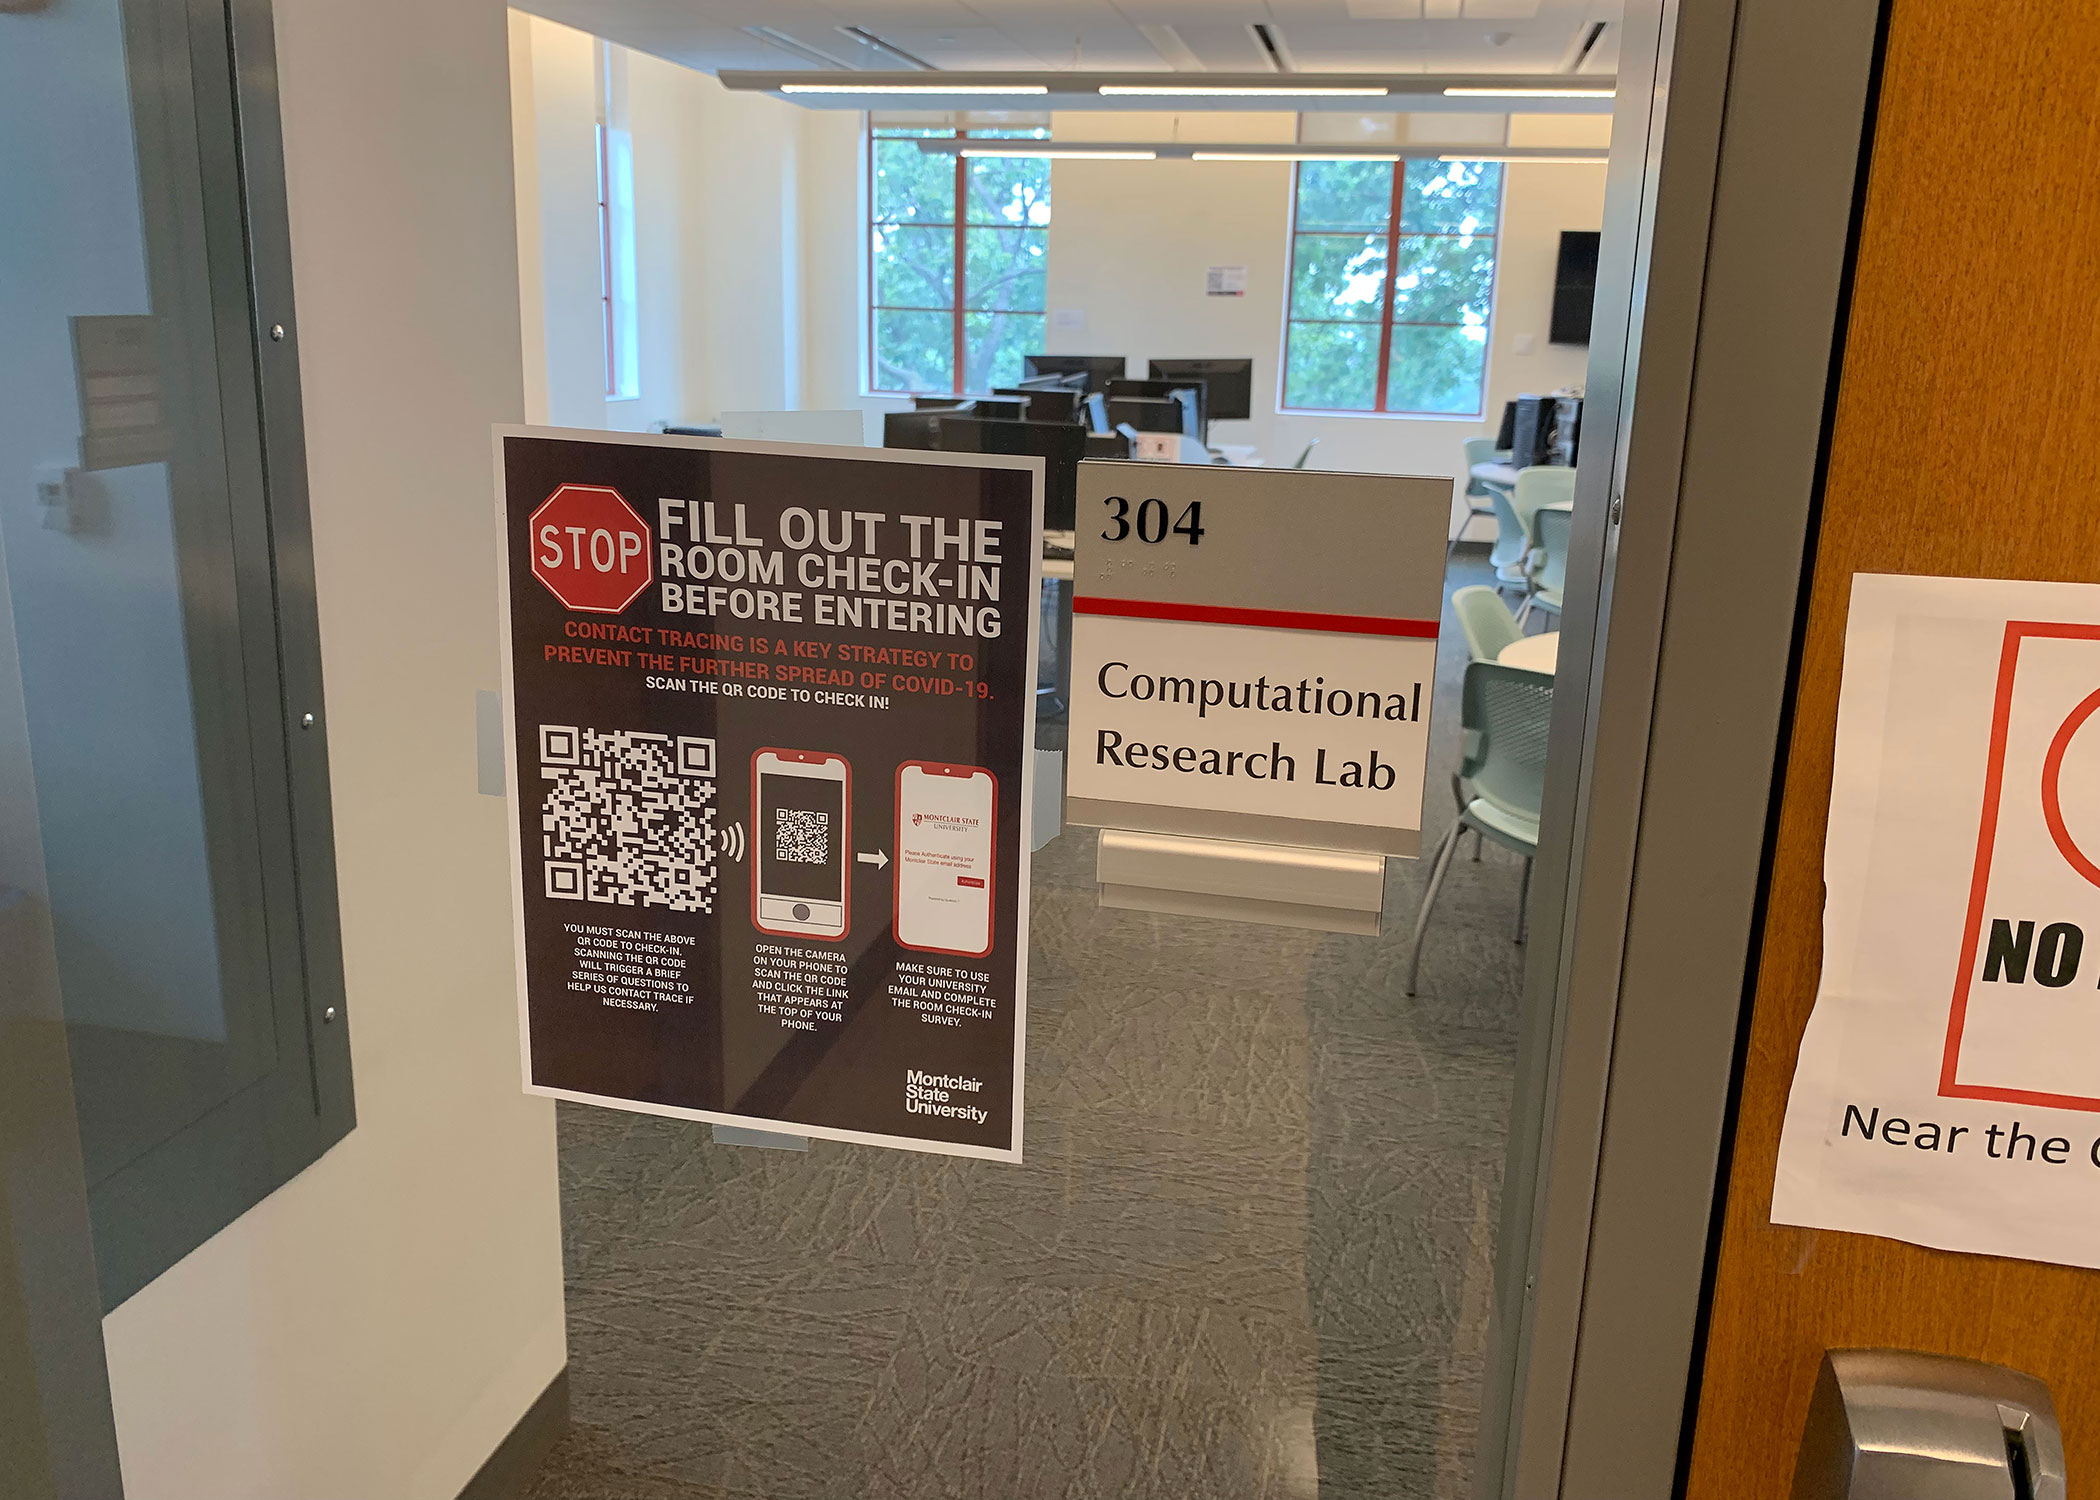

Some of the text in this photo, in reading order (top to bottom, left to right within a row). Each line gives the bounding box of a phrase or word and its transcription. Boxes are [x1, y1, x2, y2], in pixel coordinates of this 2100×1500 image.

[659, 498, 1002, 564] FILL OUT THE
[1101, 496, 1204, 545] 304
[540, 525, 642, 574] STOP
[661, 543, 1000, 601] ROOM CHECK-IN
[662, 583, 1001, 638] BEFORE ENTERING
[565, 621, 973, 672] CONTACT TRACING IS A KEY STRATEGY TO
[544, 645, 994, 699] PREVENT THE FURTHER SPREAD OF COVID-19.
[645, 676, 889, 710] SCAN THE QR CODE TO CHECK IN!
[1098, 662, 1420, 722] Computational
[1096, 729, 1396, 790] Research Lab
[924, 814, 960, 823] MONTCLAIR
[934, 824, 968, 832] UNIVERSITY
[564, 923, 695, 945] YOU MUST SCAN THE ABOVE
[577, 937, 682, 956] QR CODE TO CHECK-IN.
[756, 944, 846, 962] OPEN THE CAMERA
[1982, 919, 2084, 988] NO
[574, 948, 686, 968] SCANNING THE QR CODE
[754, 956, 847, 974] ON YOUR PHONE TO
[580, 960, 681, 979] WILL TRIGGER A BRIEF
[755, 968, 846, 986] SCAN THE QR CODE
[896, 962, 989, 982] MAKE SURE TO USE
[572, 971, 689, 992] SERIES OF QUESTIONS TO
[752, 980, 849, 998] AND CLICK THE LINK
[899, 975, 986, 994] YOUR UNIVERSITY
[567, 982, 694, 1004] HELP US CONTACT TRACE IF
[757, 992, 843, 1009] THAT APPEARS AT
[888, 985, 996, 1008] EMAIL AND COMPLETE
[603, 998, 658, 1012] NECESSARY.
[758, 1004, 842, 1022] THE TOP OF YOUR
[892, 998, 992, 1019] THE ROOM CHECK-IN
[782, 1019, 817, 1031] PHONE.
[921, 1014, 961, 1027] SURVEY.
[907, 1069, 983, 1092] Montclair
[906, 1084, 949, 1102] State
[906, 1098, 988, 1124] University
[1841, 1104, 1969, 1153] Near
[1985, 1121, 2071, 1164] the
